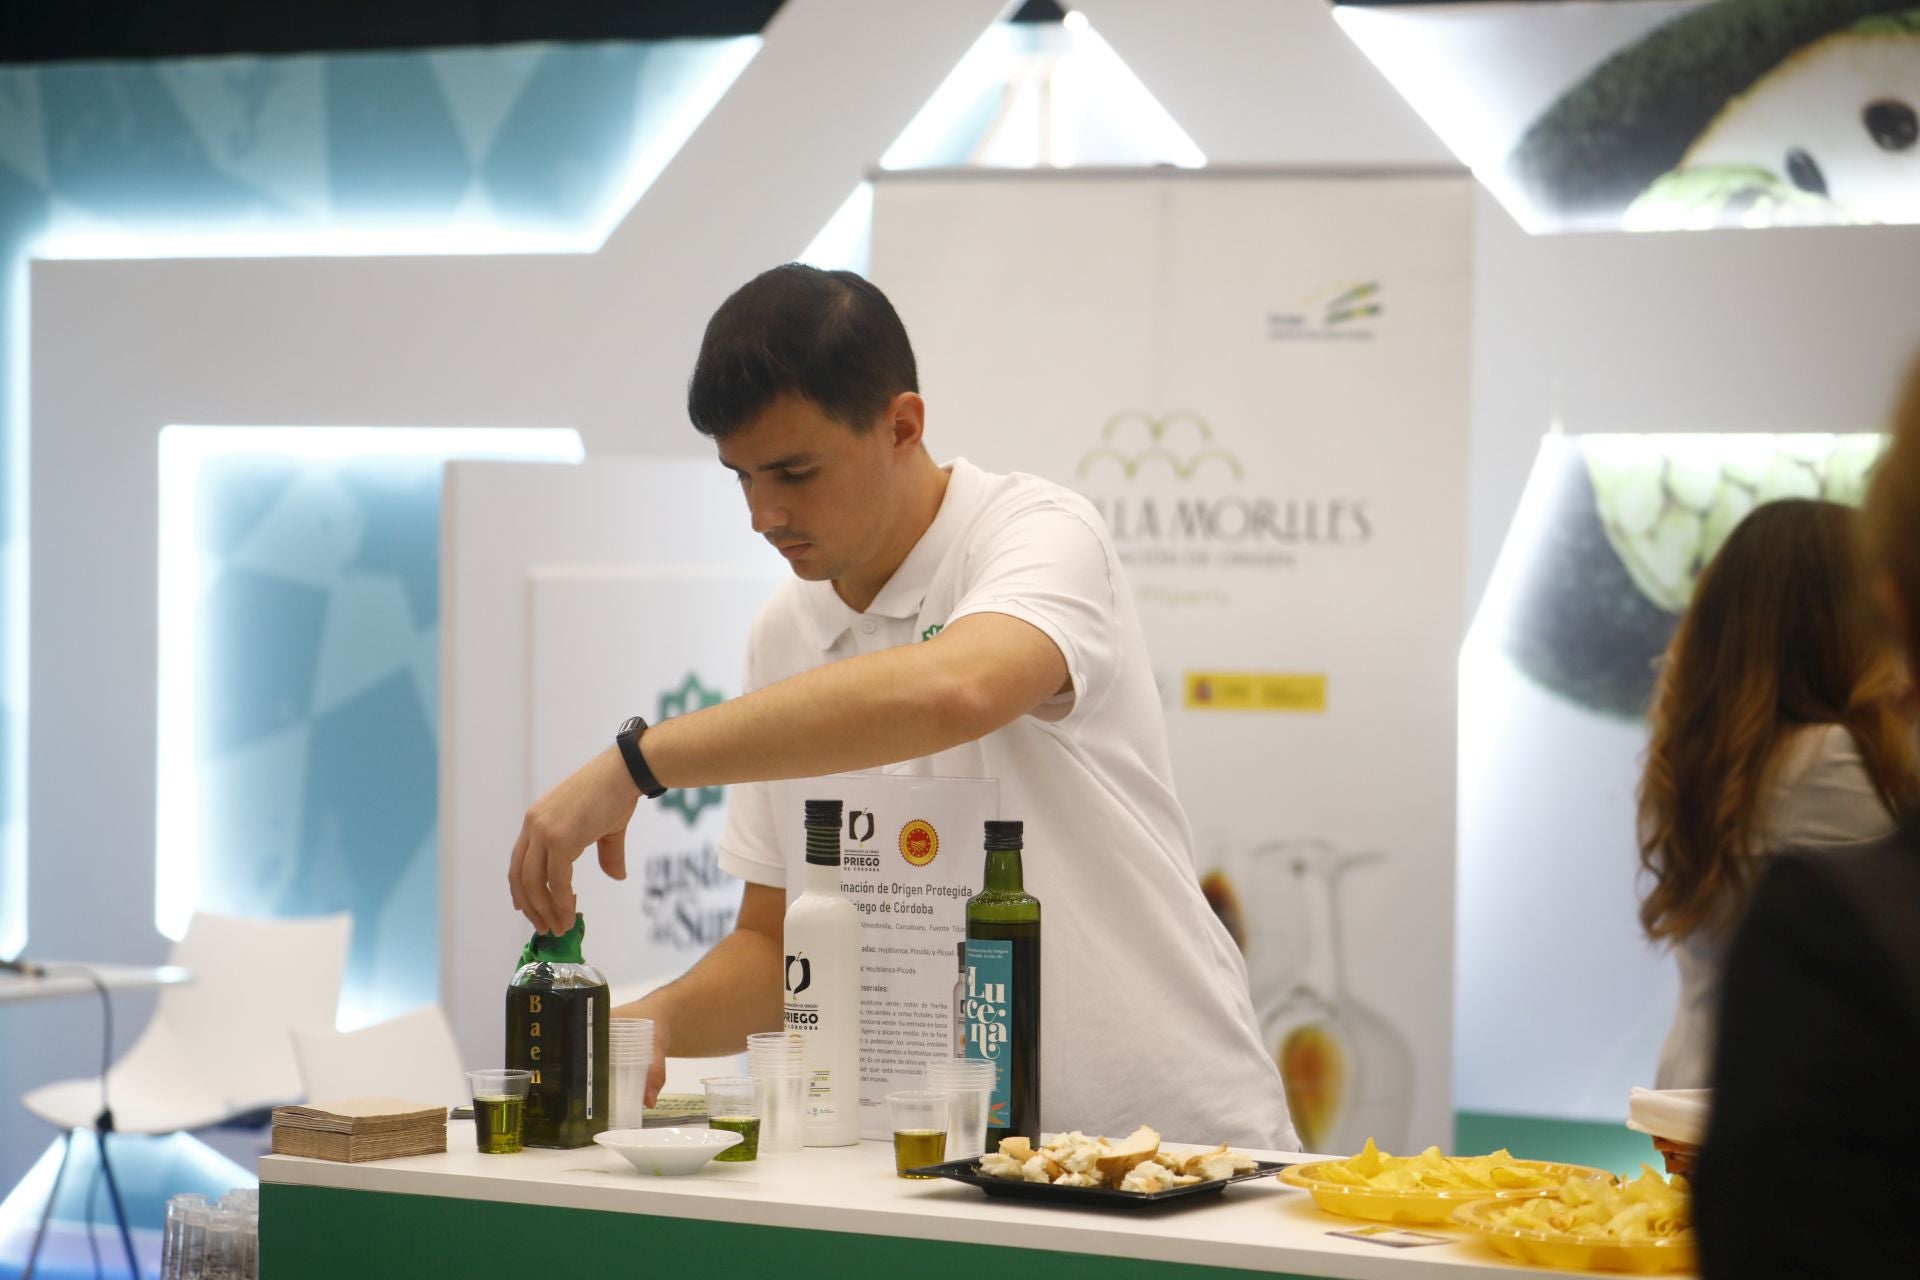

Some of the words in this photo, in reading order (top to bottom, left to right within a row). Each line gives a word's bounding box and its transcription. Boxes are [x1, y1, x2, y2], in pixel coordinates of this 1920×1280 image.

[844, 857, 880, 867] PRIEGO
[840, 881, 874, 893] inación
[877, 883, 888, 894] de
[892, 883, 923, 898] Origen
[926, 884, 973, 899] Protegida
[880, 902, 891, 913] de
[894, 901, 934, 915] Córdoba
